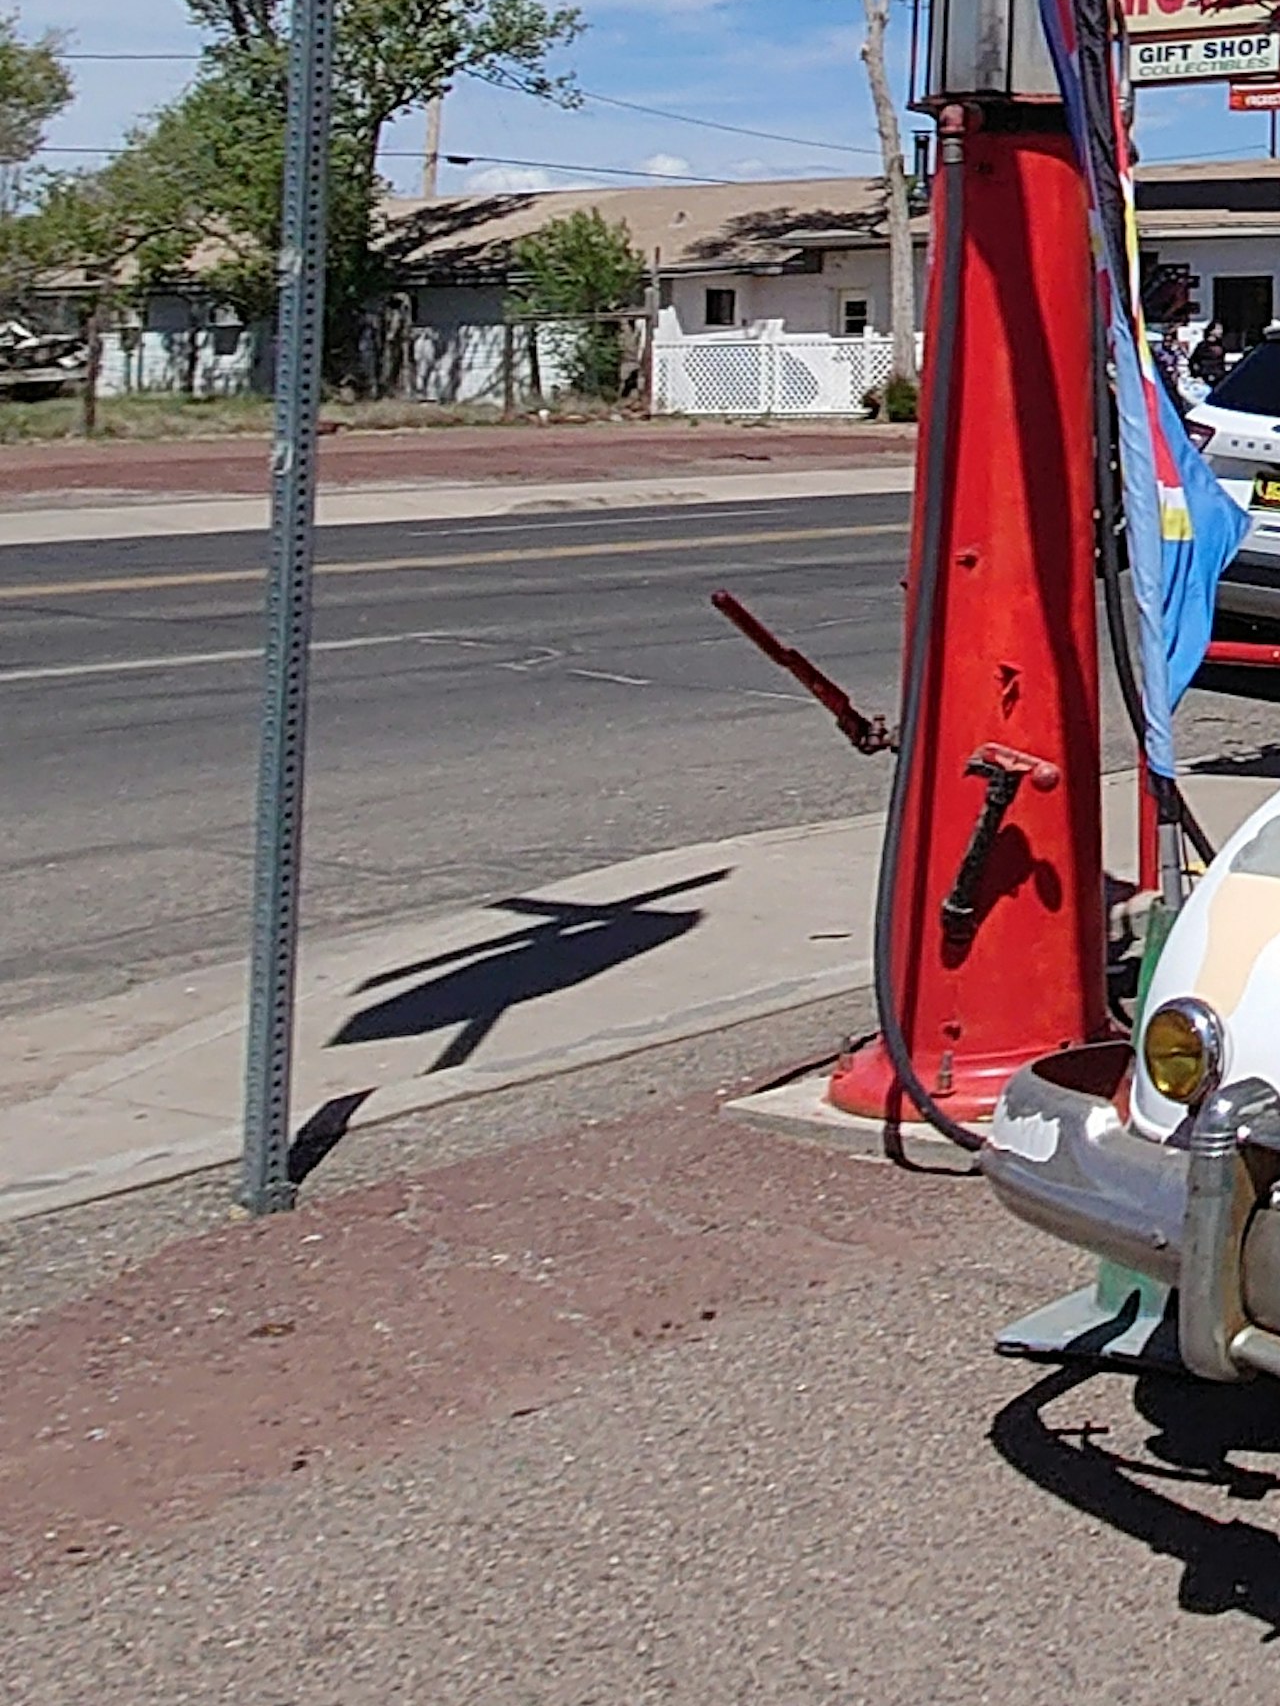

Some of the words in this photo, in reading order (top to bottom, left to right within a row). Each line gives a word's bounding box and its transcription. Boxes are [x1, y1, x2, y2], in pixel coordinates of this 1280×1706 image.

[1138, 45, 1192, 64] GIFT
[1203, 38, 1271, 60] SHOP
[1138, 57, 1271, 77] COLLECTIBLES
